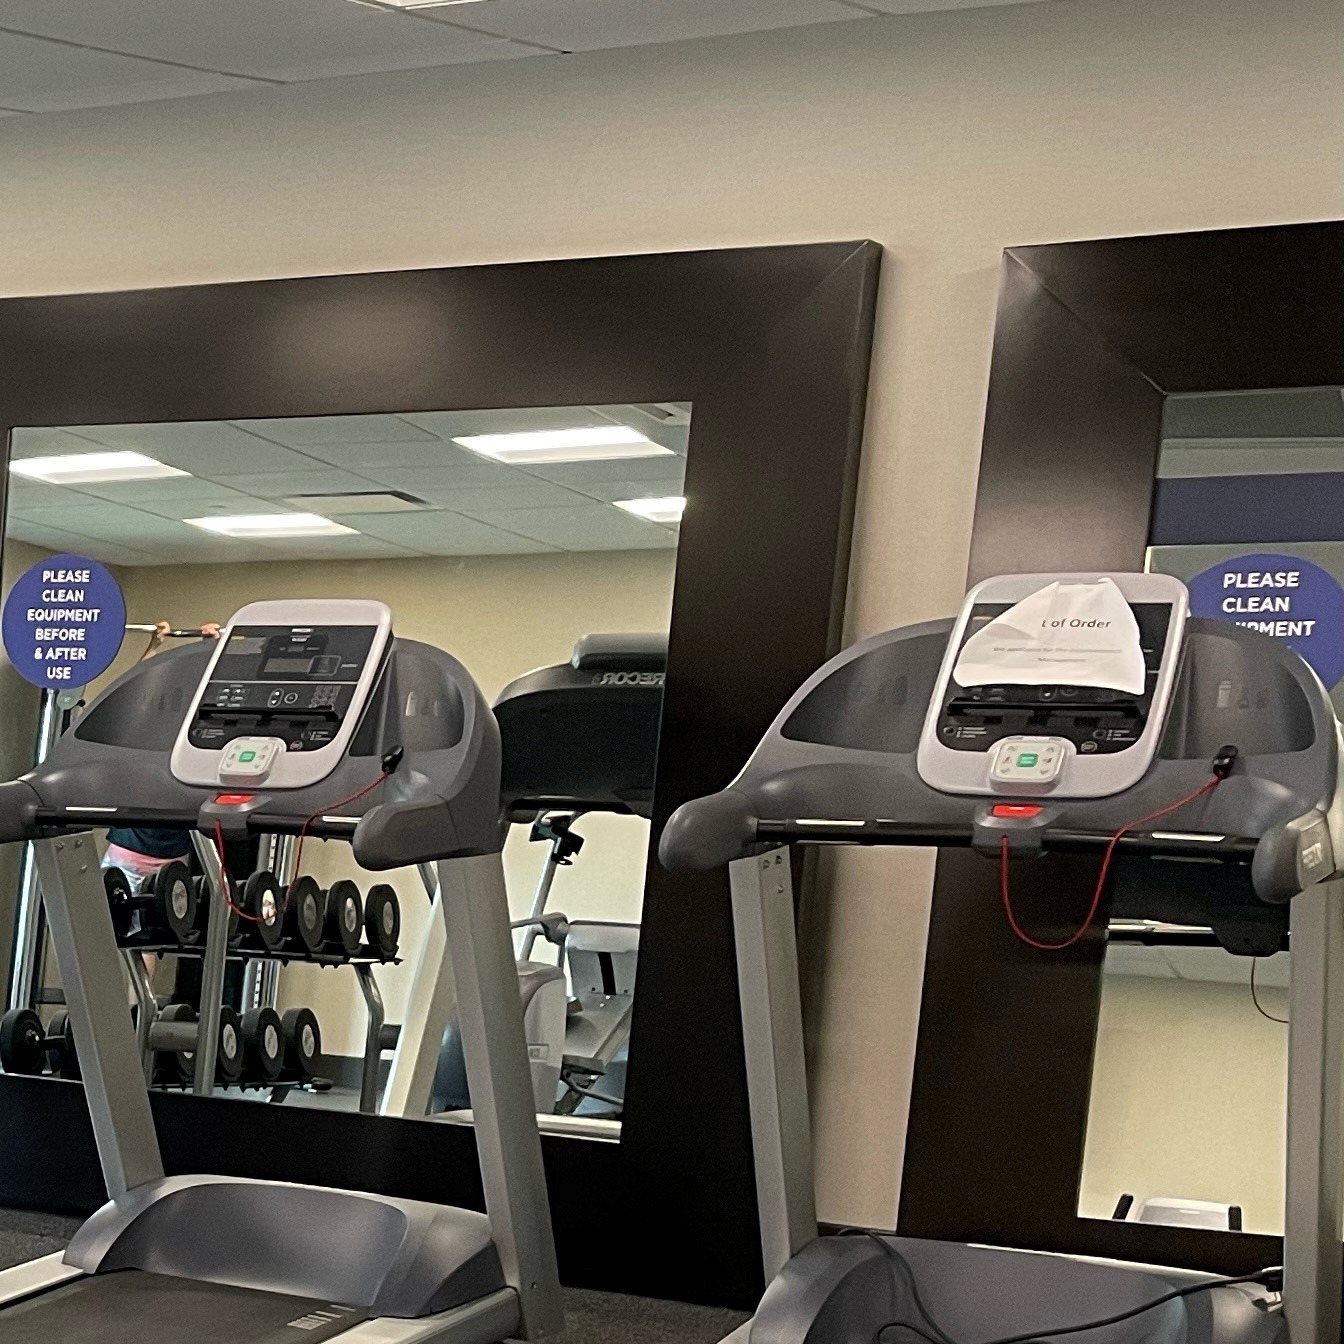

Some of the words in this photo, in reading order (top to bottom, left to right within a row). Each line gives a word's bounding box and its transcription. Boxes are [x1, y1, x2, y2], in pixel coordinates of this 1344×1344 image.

[42, 570, 90, 583] PLEASE
[1223, 572, 1300, 588] PLEASE
[42, 589, 84, 602] CLEAN
[1222, 596, 1290, 613] CLEAN
[27, 608, 100, 622] EQUIPMENT
[1051, 618, 1067, 628] of
[1069, 618, 1112, 628] Order
[35, 628, 86, 641] BEFORE
[34, 647, 43, 660] &
[45, 647, 87, 660] AFTER
[46, 666, 72, 679] USE
